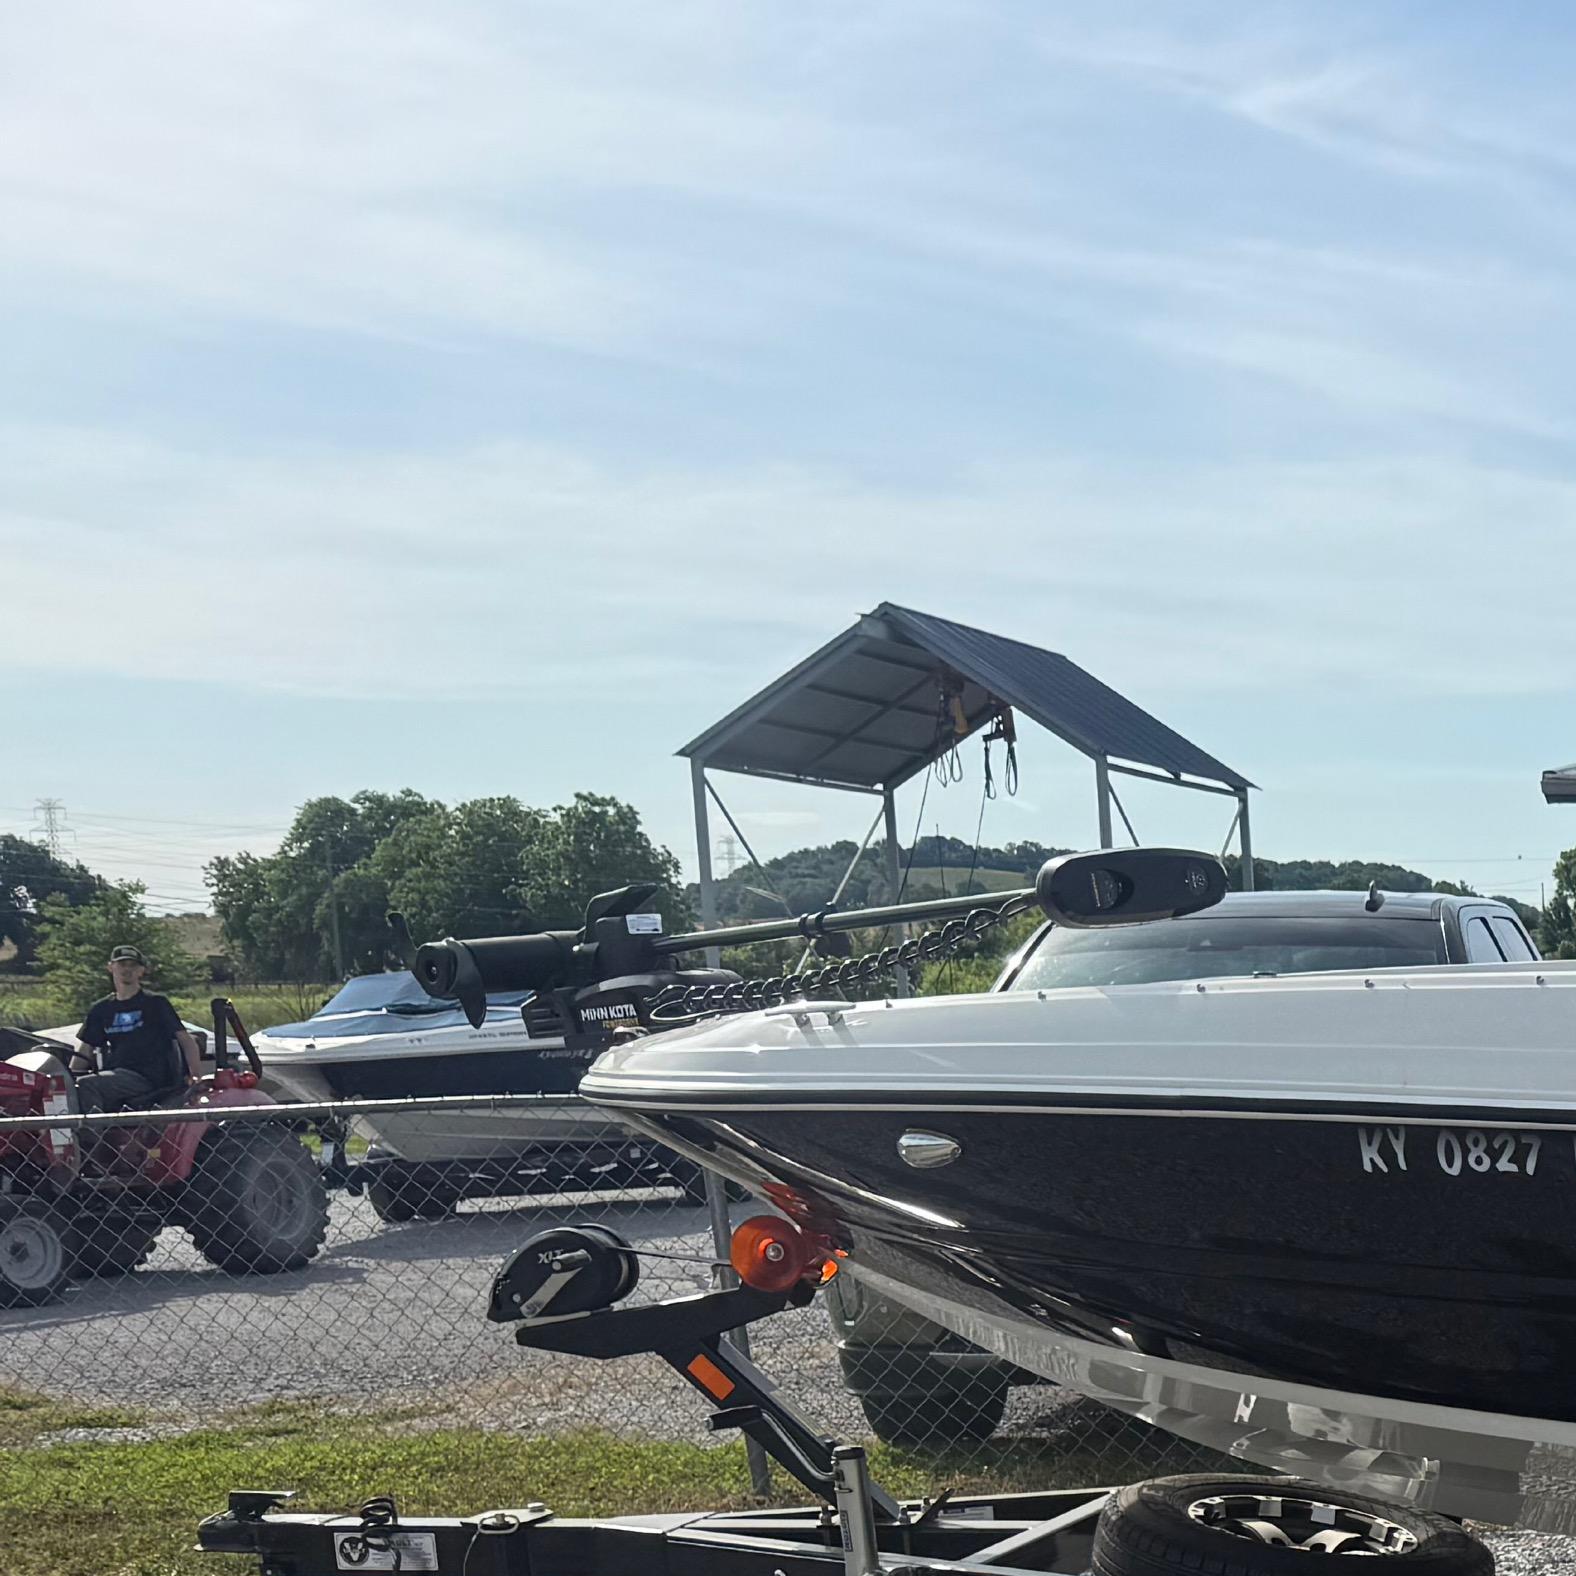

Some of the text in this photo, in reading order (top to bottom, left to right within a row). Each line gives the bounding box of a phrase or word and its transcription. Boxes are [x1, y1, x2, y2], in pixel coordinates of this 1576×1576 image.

[580, 1003, 637, 1022] MINN KOTA
[1358, 1125, 1408, 1173] KY
[1436, 1129, 1542, 1177] 0827
